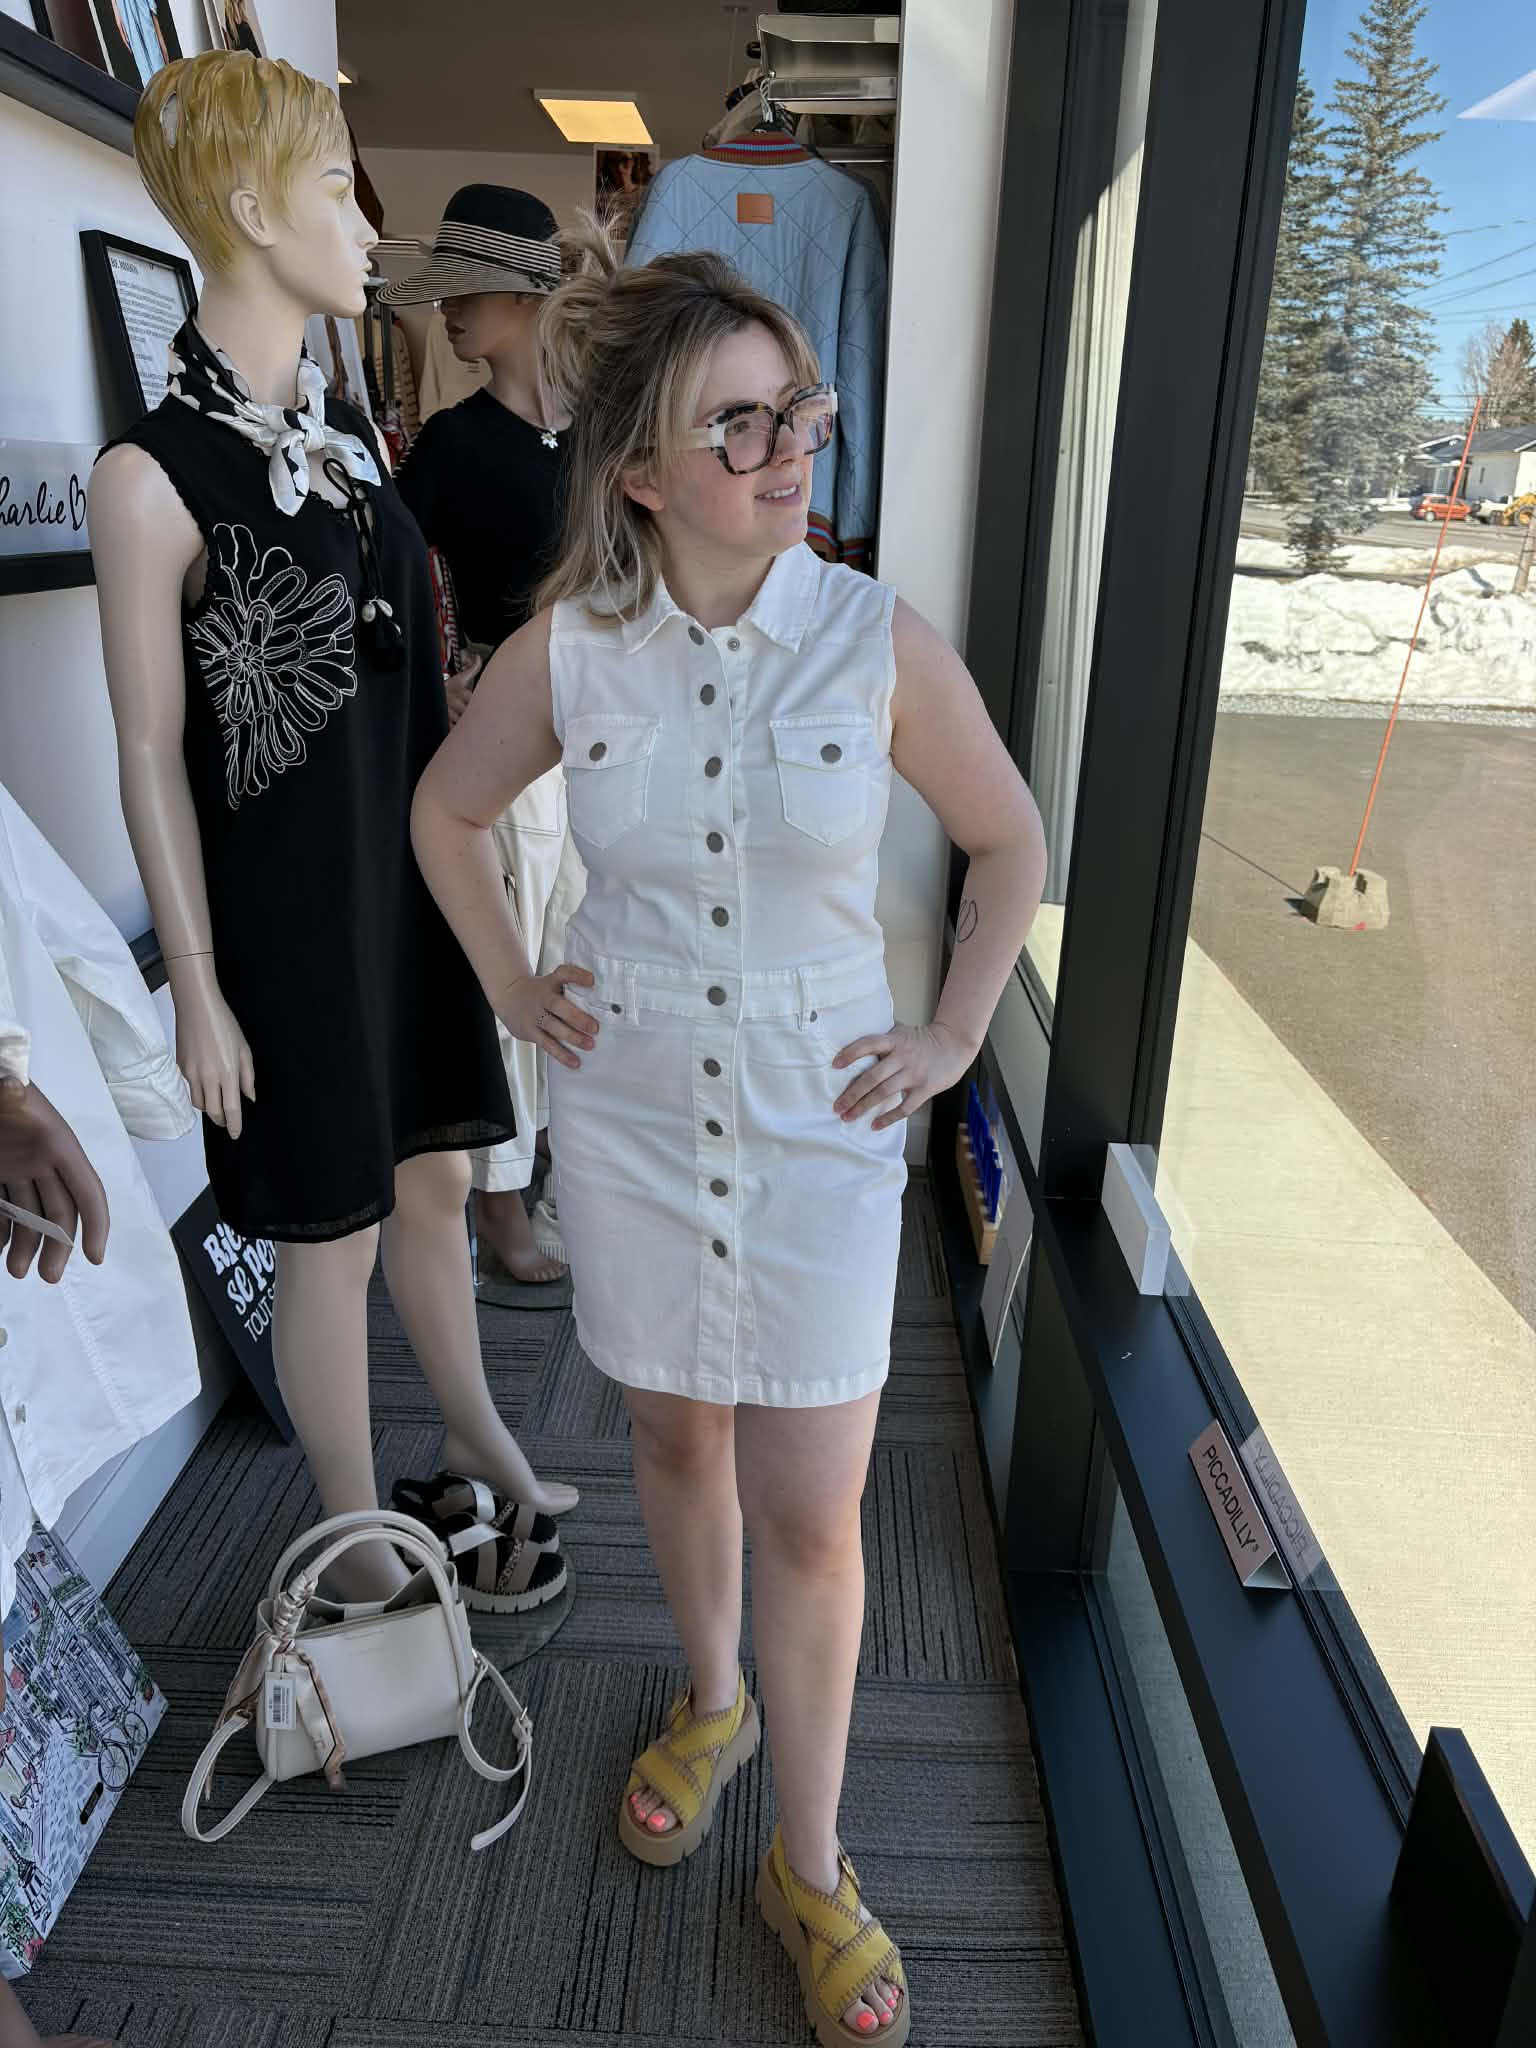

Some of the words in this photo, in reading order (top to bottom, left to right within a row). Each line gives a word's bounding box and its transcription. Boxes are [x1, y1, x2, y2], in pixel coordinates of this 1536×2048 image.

[0, 475, 67, 526] harlie
[202, 1222, 248, 1276] Rie
[227, 1265, 254, 1316] se
[242, 1238, 276, 1291] pe
[244, 1295, 273, 1343] TOUT
